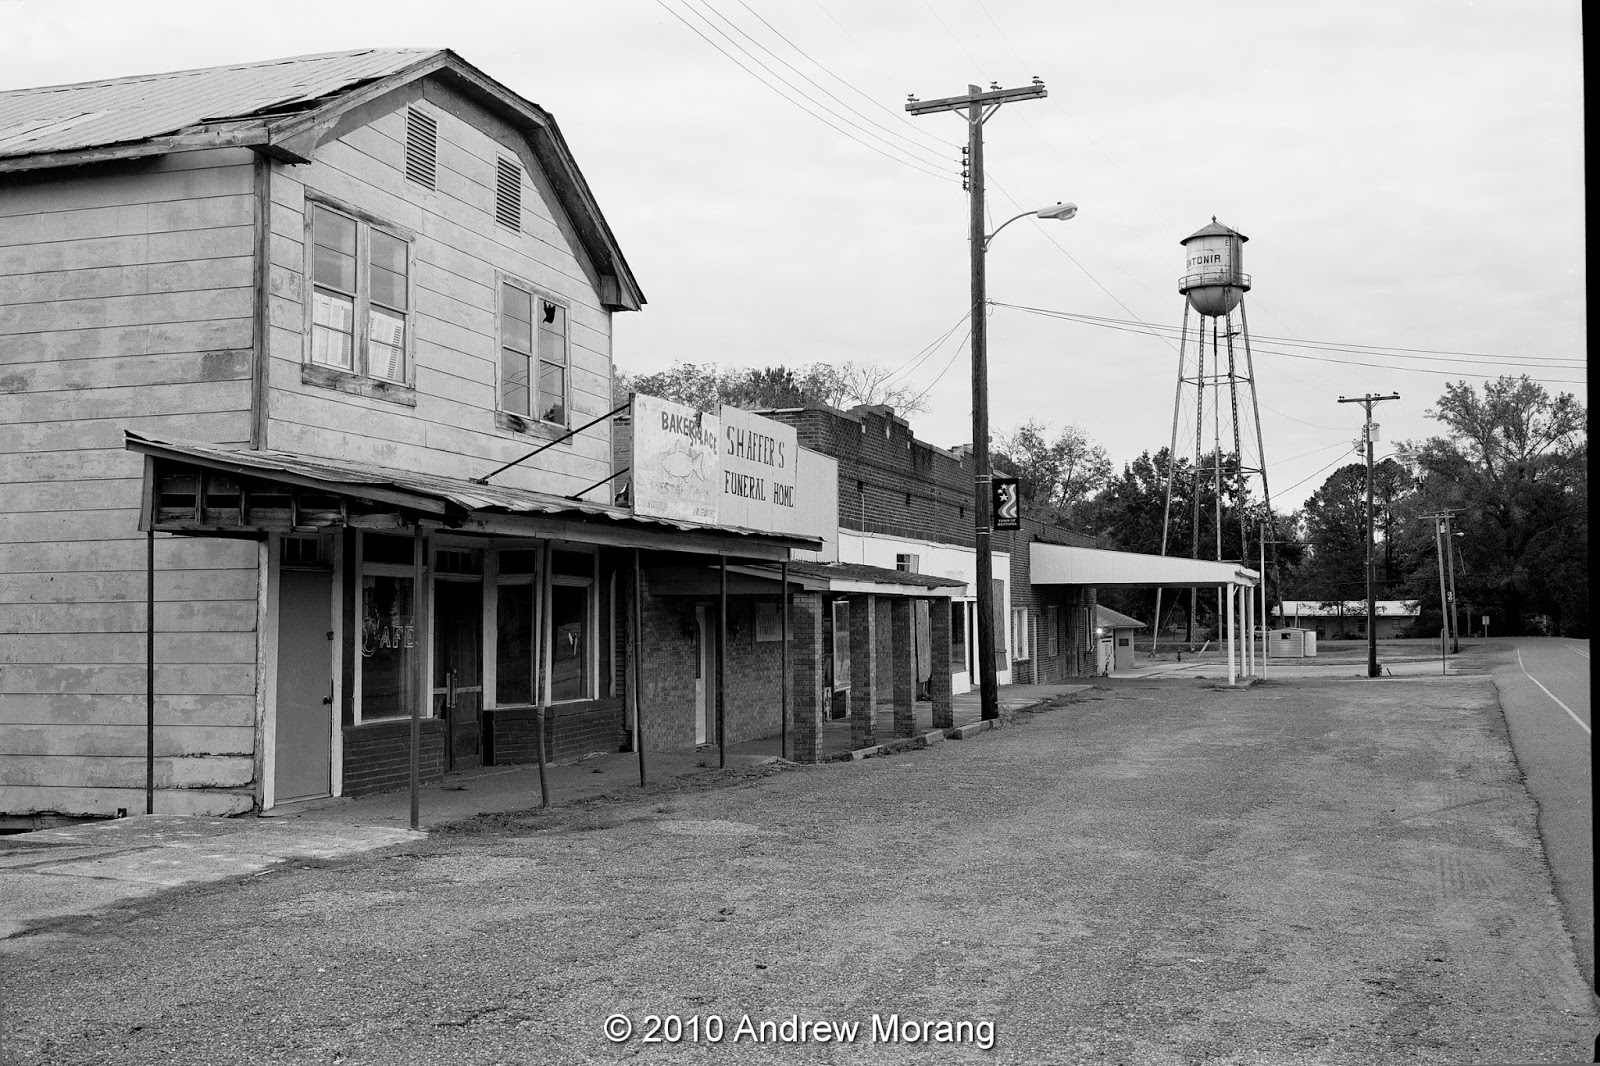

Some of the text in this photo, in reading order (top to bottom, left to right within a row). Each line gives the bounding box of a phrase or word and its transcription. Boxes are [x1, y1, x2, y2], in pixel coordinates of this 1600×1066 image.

[726, 425, 785, 469] SHAFFER'S
[724, 469, 766, 501] FUNERAL
[773, 482, 794, 508] HOME
[361, 618, 414, 657] CAFE
